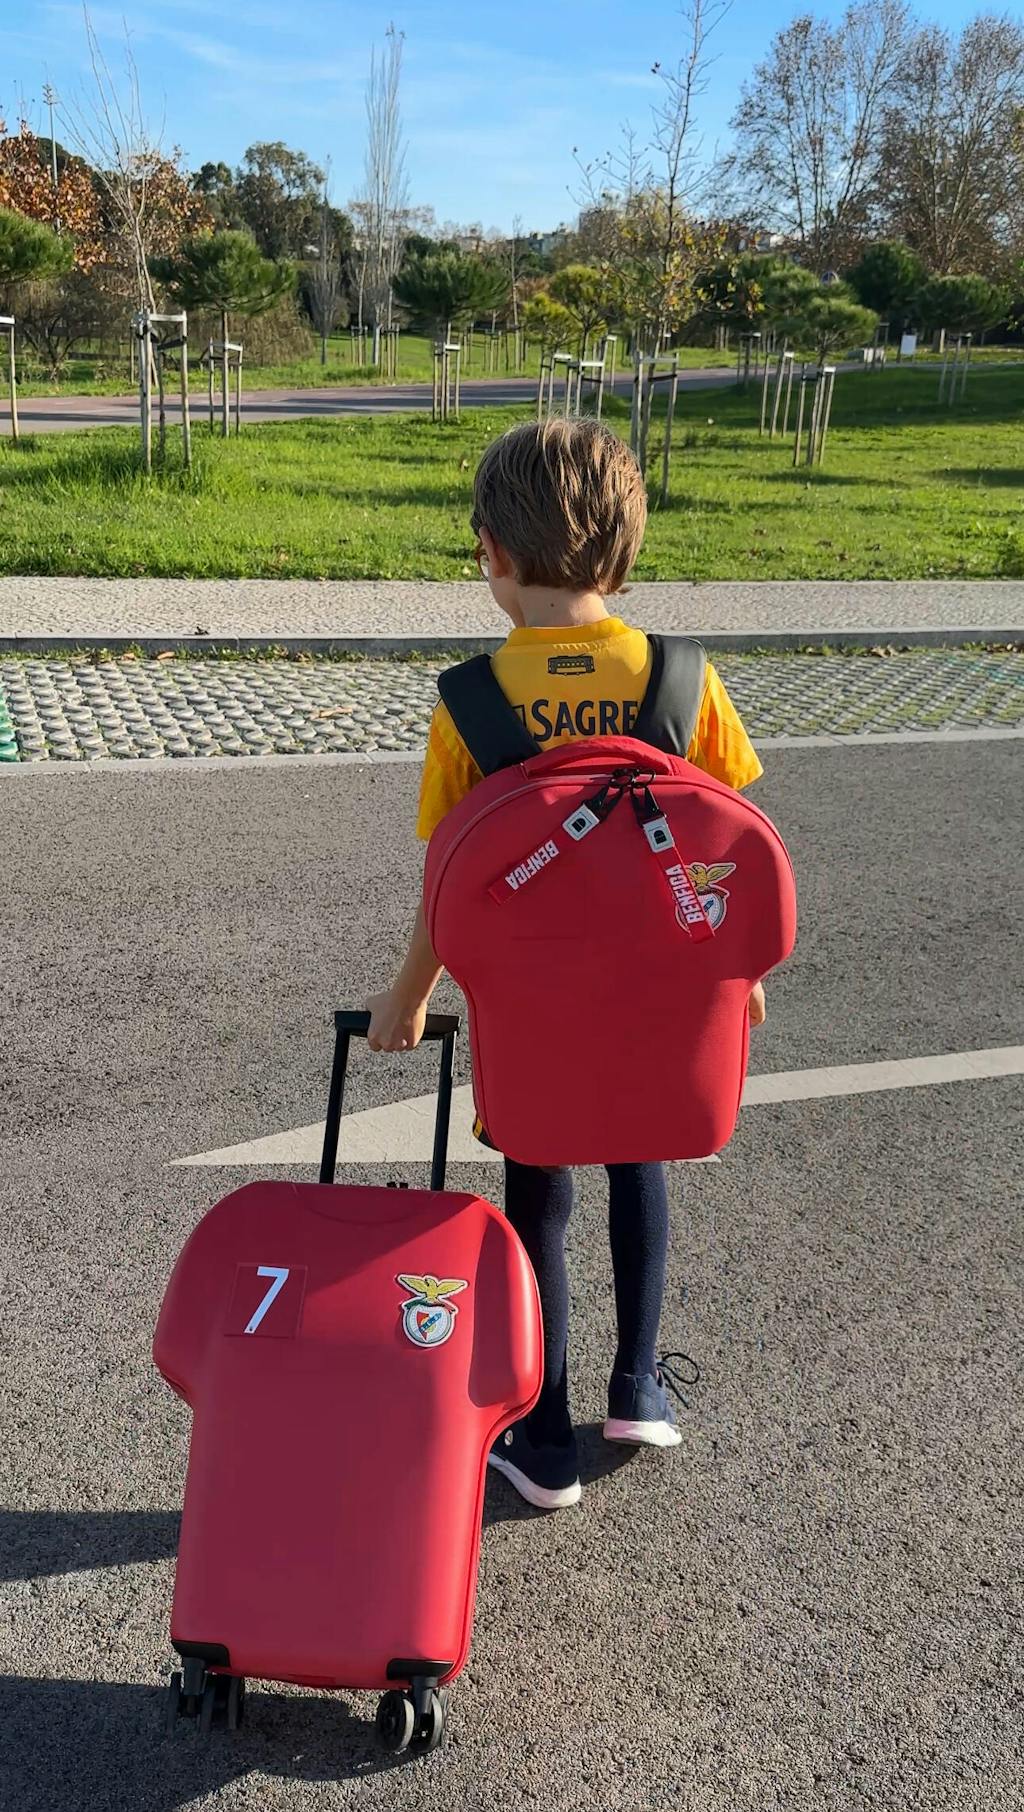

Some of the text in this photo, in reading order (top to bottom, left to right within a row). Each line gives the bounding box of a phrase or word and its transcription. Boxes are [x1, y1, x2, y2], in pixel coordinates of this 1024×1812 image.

[505, 840, 559, 890] BENFICA
[665, 863, 705, 923] BENFICA
[244, 1265, 290, 1333] 7
